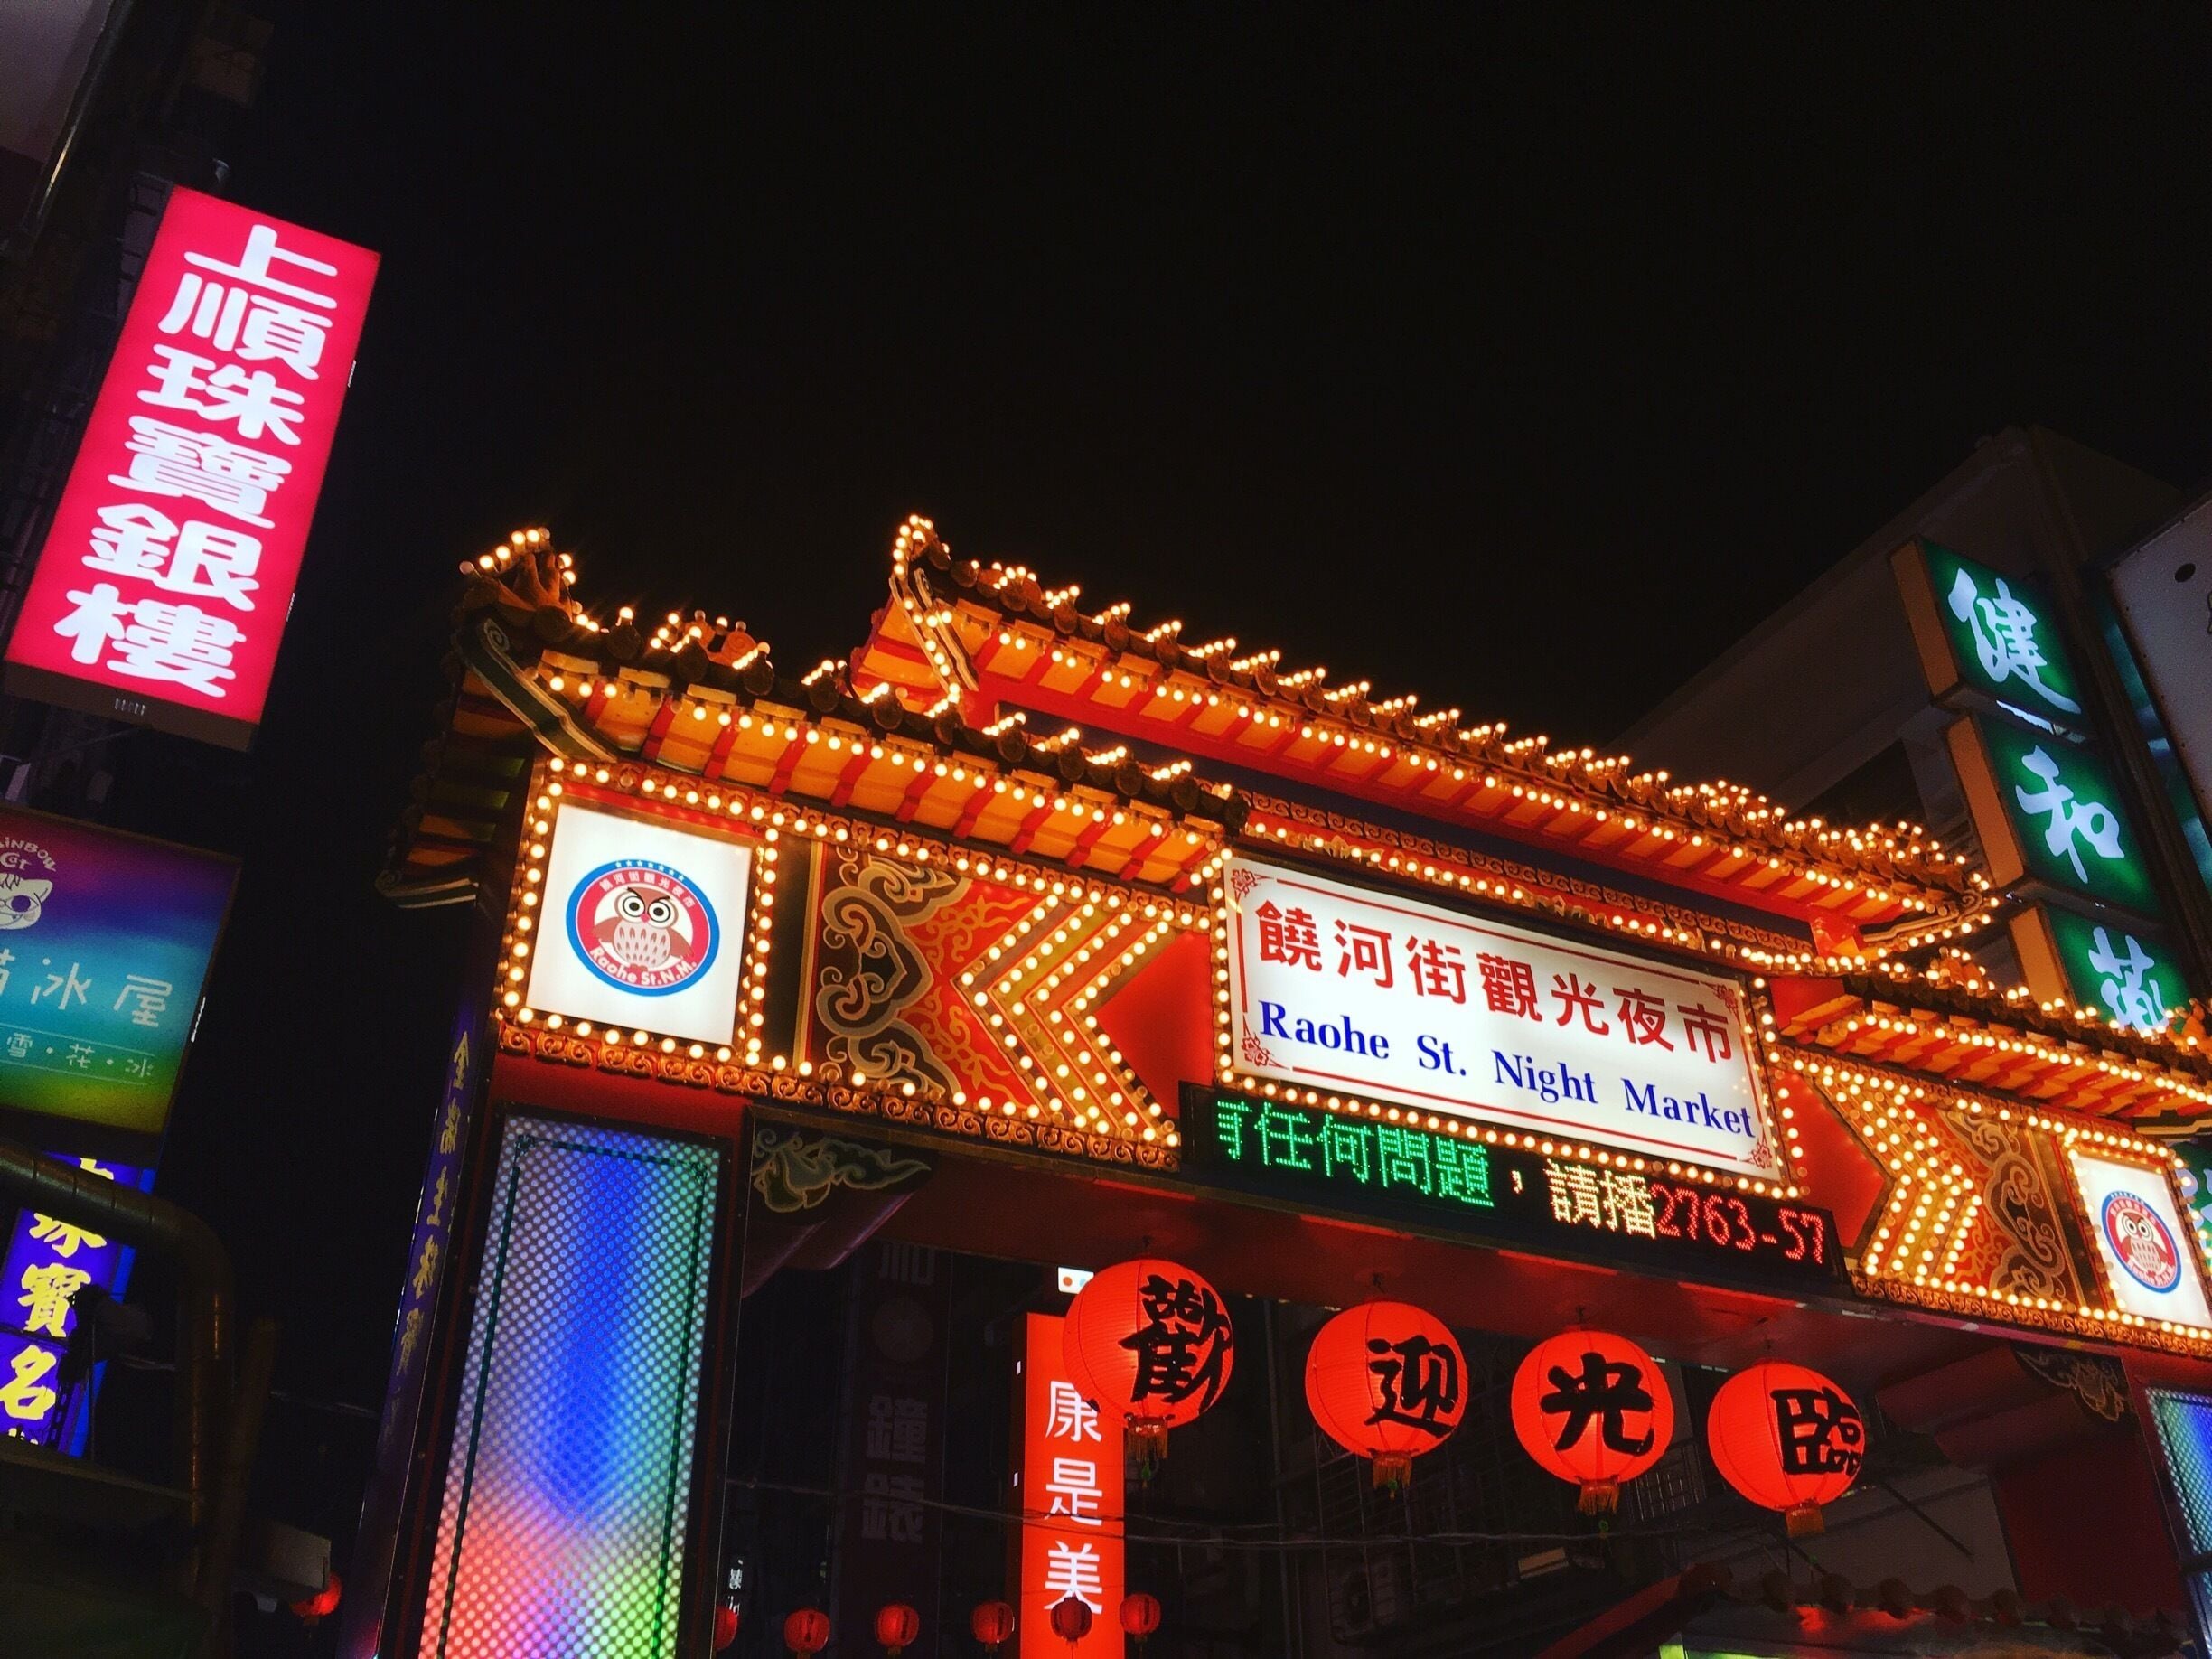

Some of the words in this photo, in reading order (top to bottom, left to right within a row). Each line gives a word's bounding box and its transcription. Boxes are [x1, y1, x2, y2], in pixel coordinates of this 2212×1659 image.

[53, 224, 338, 698] 上順珠寶銀樓
[589, 947, 638, 985] Raohe
[1255, 900, 1733, 1064] 饒河街觀光夜市
[1258, 999, 1390, 1061] Raohe
[1418, 1036, 1467, 1077] St.
[1494, 1050, 1598, 1105] Night
[1623, 1077, 1757, 1139] Market
[1044, 1380, 1103, 1616] 康是美
